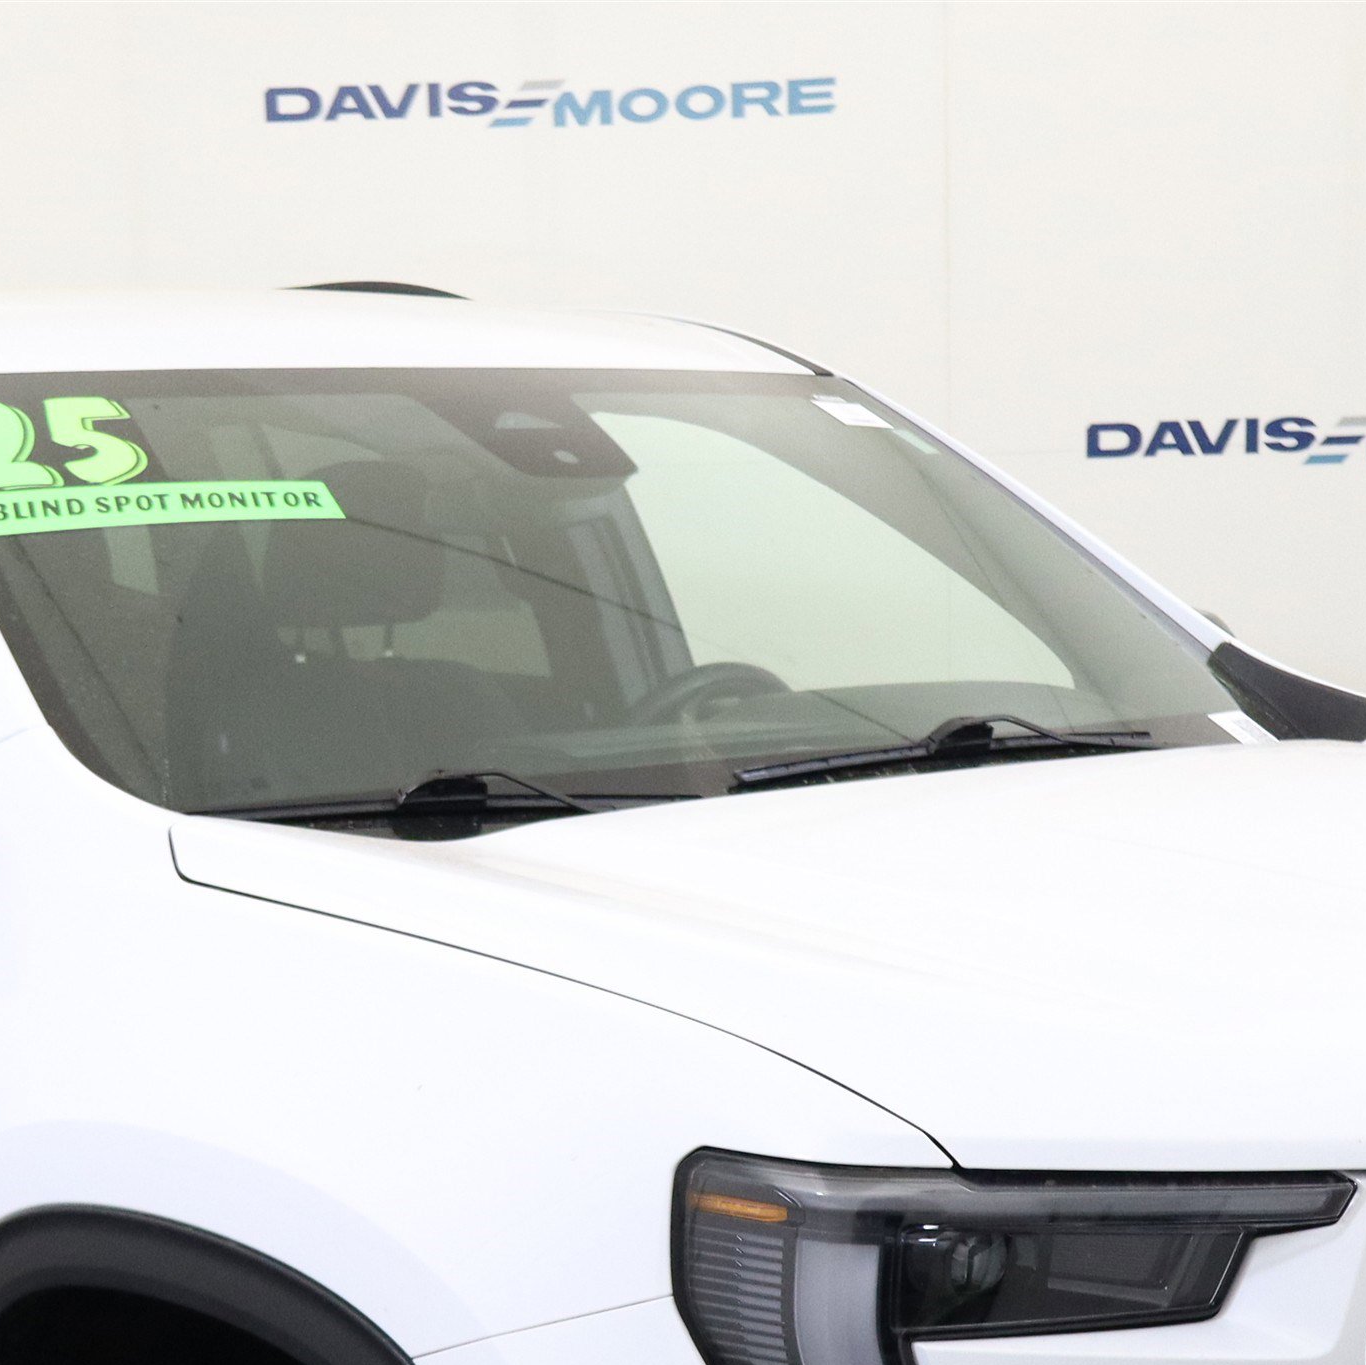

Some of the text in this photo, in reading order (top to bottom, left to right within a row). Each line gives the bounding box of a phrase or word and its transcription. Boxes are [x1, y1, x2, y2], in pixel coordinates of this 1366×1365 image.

[263, 76, 837, 128] DAVIS MOORE
[1085, 416, 1319, 459] DAVIS
[94, 492, 169, 514] SPOT
[179, 490, 323, 510] MONITOR
